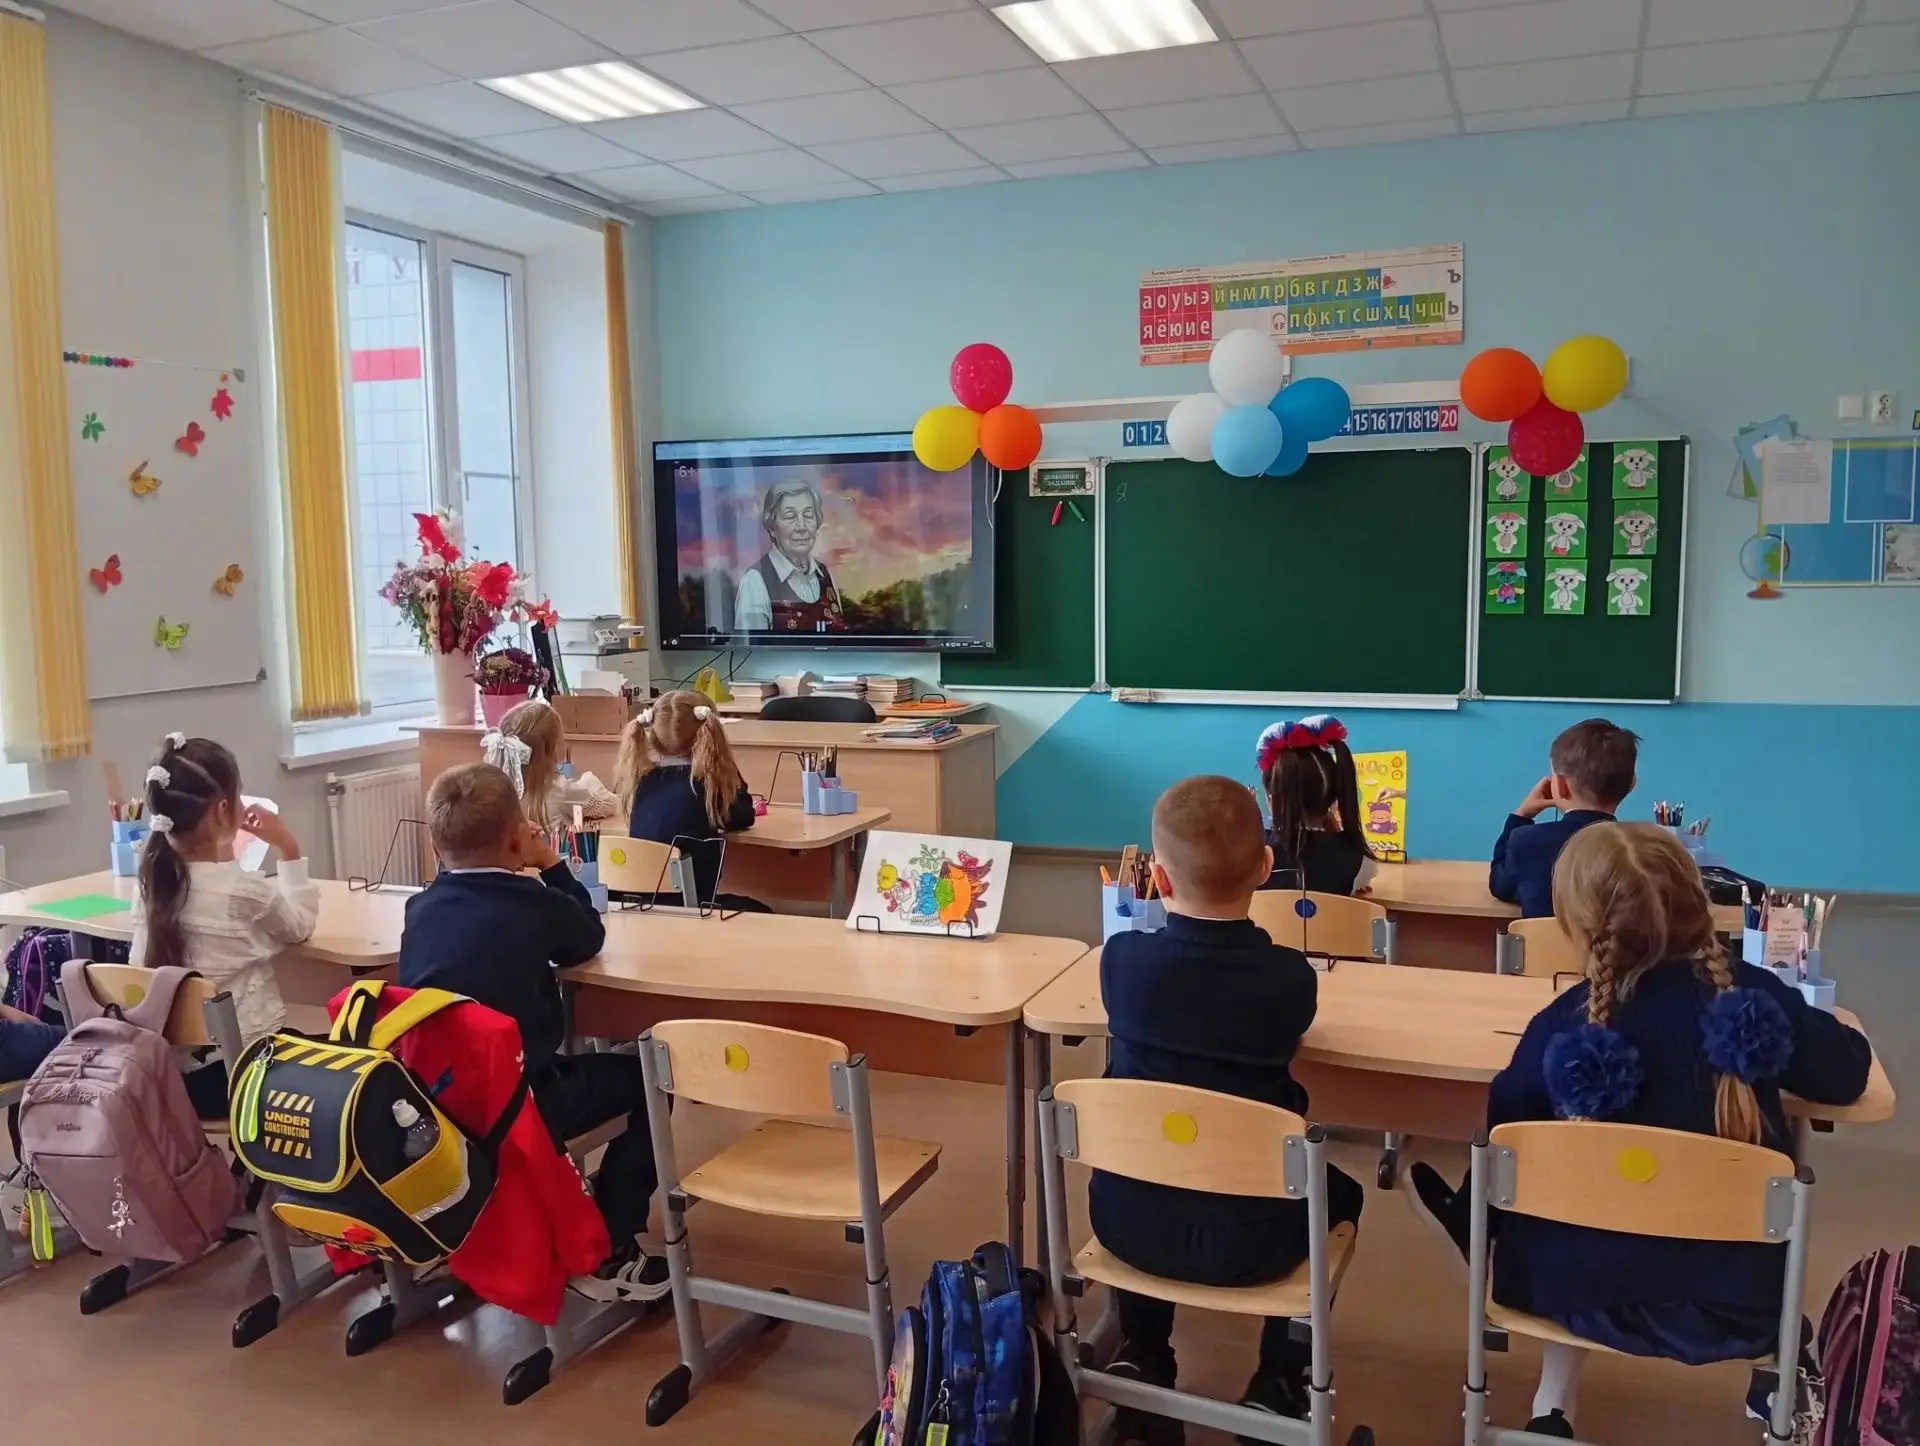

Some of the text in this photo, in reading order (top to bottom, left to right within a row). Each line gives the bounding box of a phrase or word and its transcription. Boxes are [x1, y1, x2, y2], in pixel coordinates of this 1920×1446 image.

[1126, 428, 1135, 443] 0
[1141, 428, 1147, 442] 1
[1154, 428, 1163, 442] 2
[1354, 414, 1368, 431] 15
[1371, 413, 1386, 430] 16
[1389, 412, 1404, 430] 17
[1406, 411, 1421, 429] 18
[1424, 411, 1439, 428] 19
[1441, 409, 1457, 427] 20
[679, 466, 695, 478] 6+
[264, 1111, 310, 1127] UNDER
[264, 1122, 310, 1139] CONSTRUCTION
